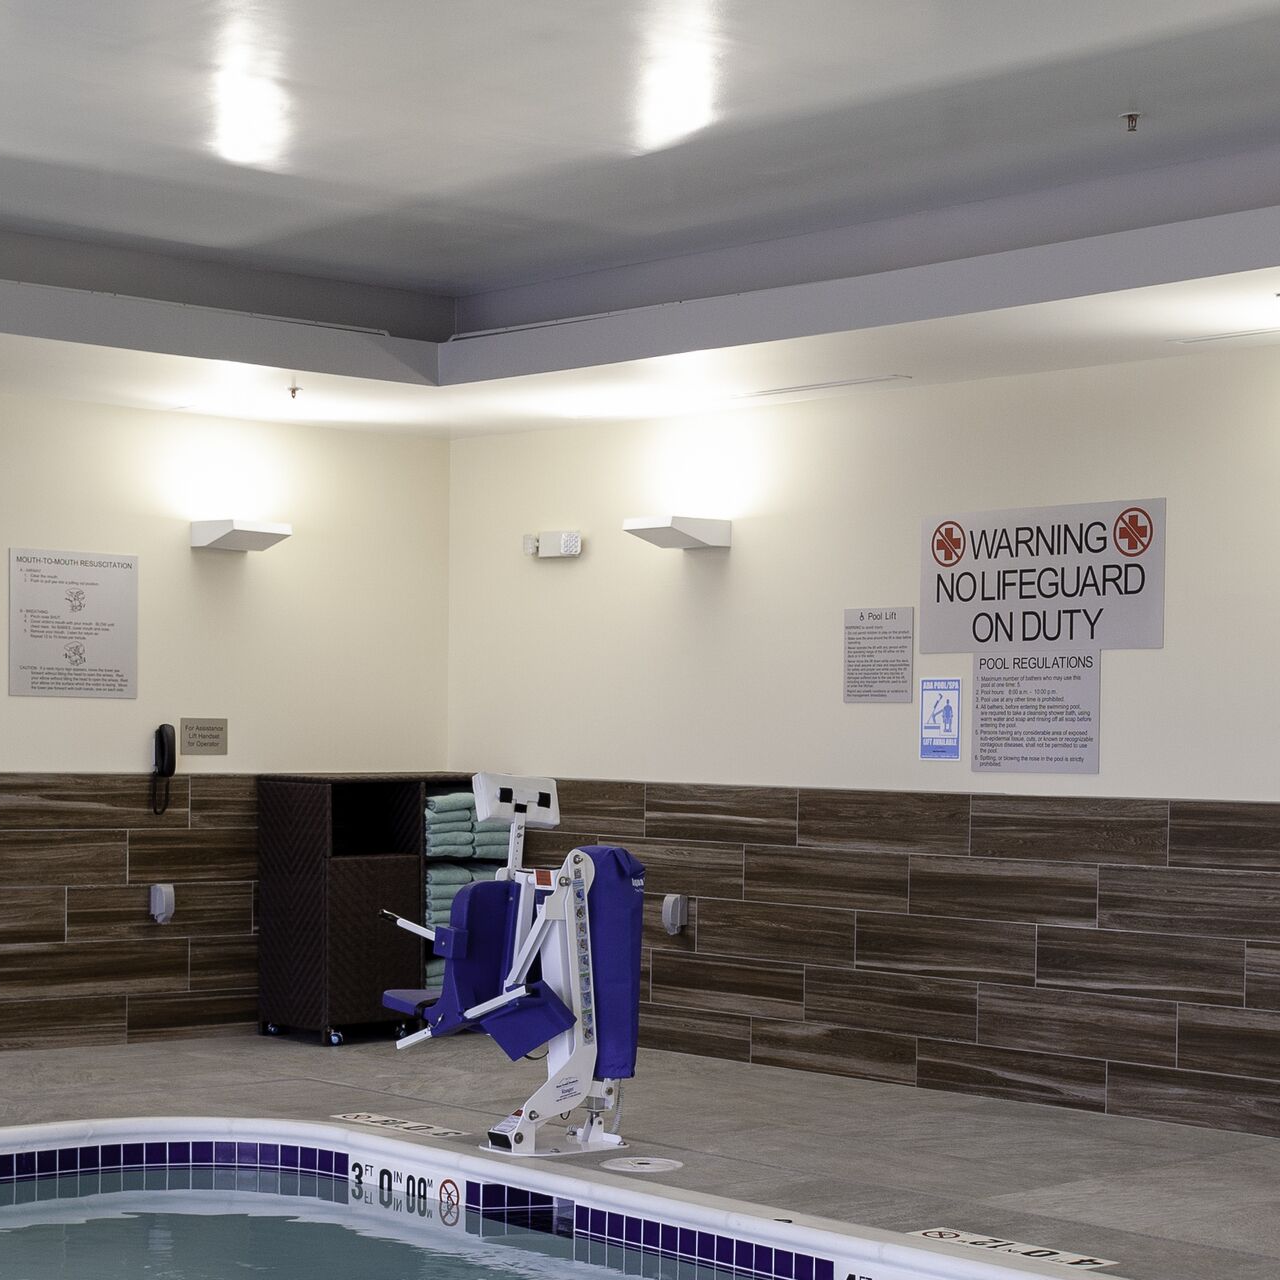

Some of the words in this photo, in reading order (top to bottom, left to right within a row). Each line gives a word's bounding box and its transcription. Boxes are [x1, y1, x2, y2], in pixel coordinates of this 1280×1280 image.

[970, 522, 1107, 560] WARNING
[16, 556, 78, 566] MOUTH-TO-MOUTH
[80, 560, 132, 569] RESUSCITATION
[936, 572, 977, 603] NO
[981, 564, 1145, 600] LIFEGUARD
[868, 612, 882, 620] Pool
[885, 612, 896, 620] Lift
[972, 612, 1013, 642] ON
[1022, 608, 1104, 642] DUTY
[980, 658, 1009, 670] POOL
[1013, 656, 1093, 669] REGULATIONS
[365, 1164, 374, 1176] FT
[380, 1169, 392, 1191] 0
[394, 1171, 402, 1184] IN
